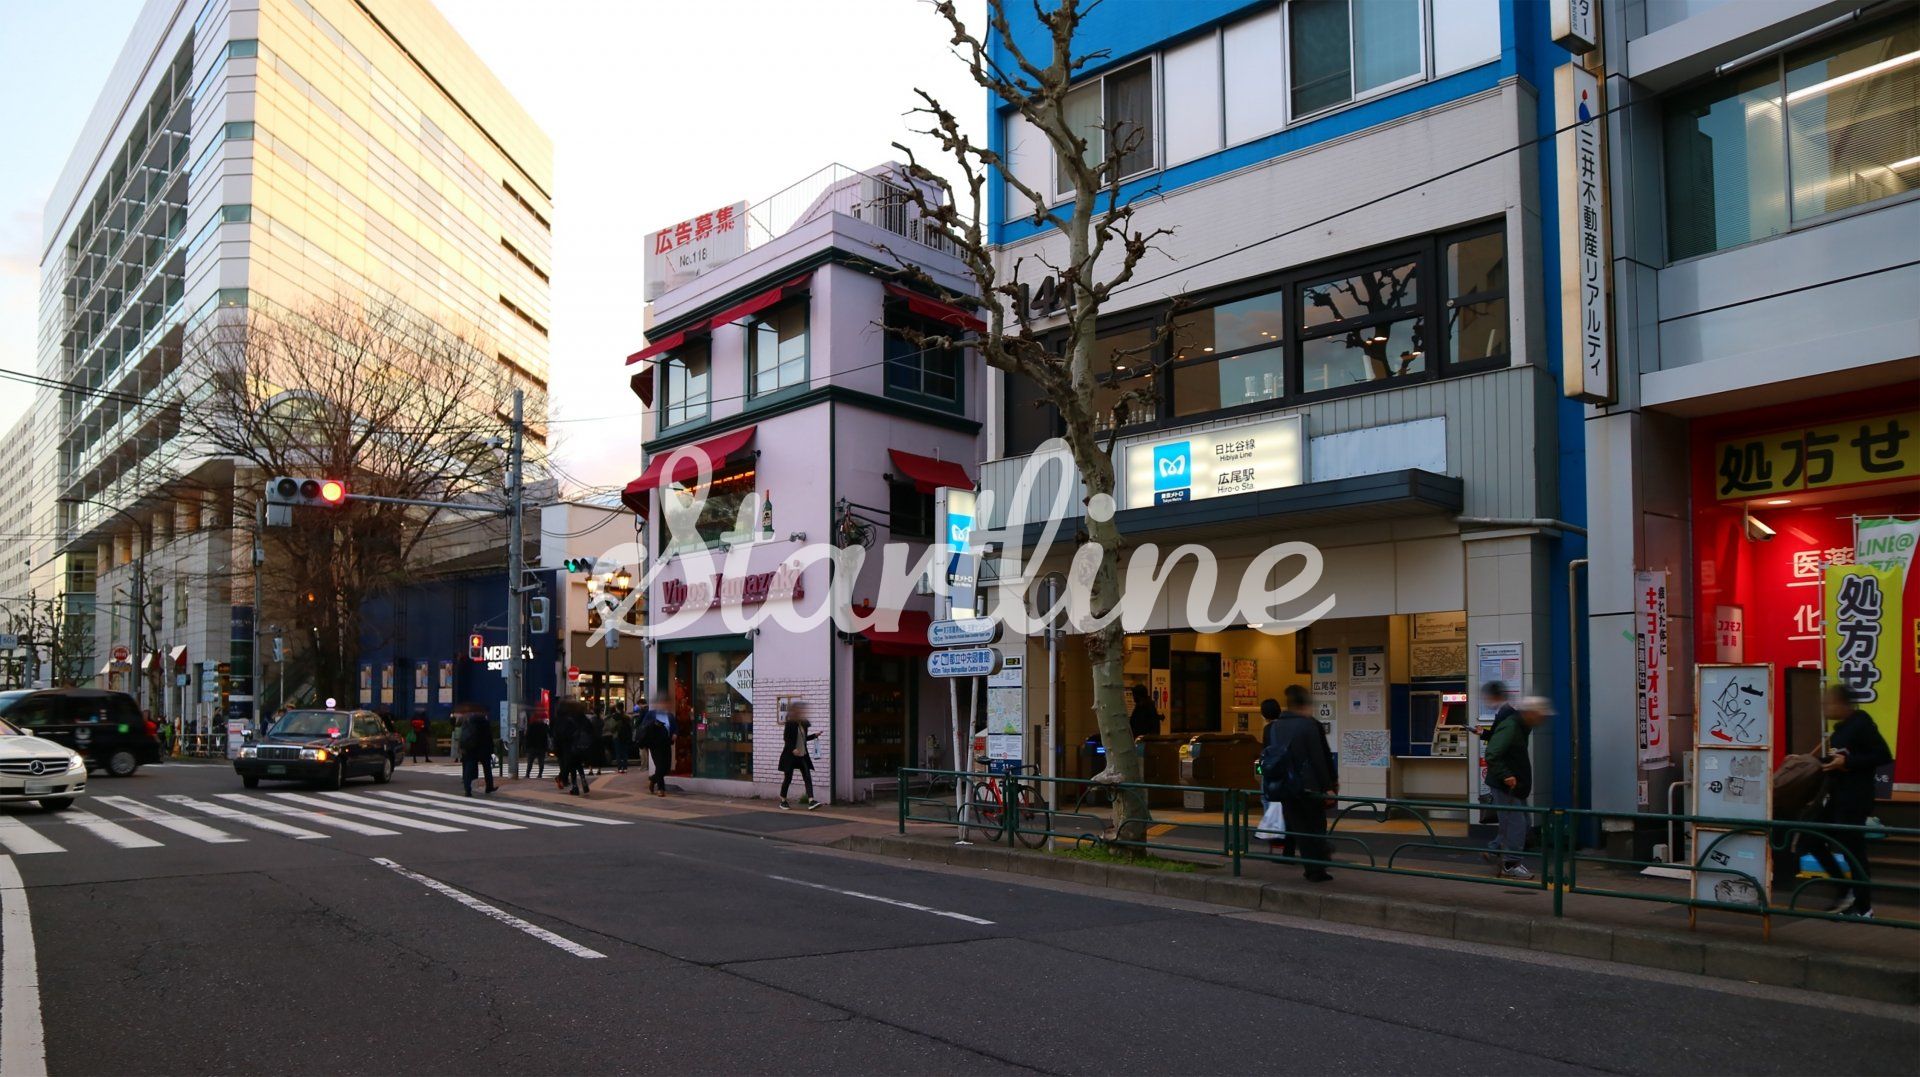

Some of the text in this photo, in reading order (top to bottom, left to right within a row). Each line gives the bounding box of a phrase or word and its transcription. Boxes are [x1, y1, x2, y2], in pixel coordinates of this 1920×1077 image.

[655, 206, 735, 255] 広告募集
[1580, 129, 1601, 377] 三井不動産リアルティ
[1215, 438, 1256, 456] 日比谷線
[1219, 451, 1253, 462] Hibiya Line
[1719, 420, 1910, 495] 処方せ
[1217, 467, 1255, 485] 広尾駅
[1161, 491, 1184, 499] 東京メトロ
[1217, 484, 1240, 494] Hiro-o
[1858, 533, 1914, 558] LINE@
[661, 559, 804, 605] Vinos Yamazaki
[1717, 620, 1741, 632] コスモス
[949, 651, 991, 665] 都立中央図書館
[1646, 587, 1661, 746] キヨーレオピン
